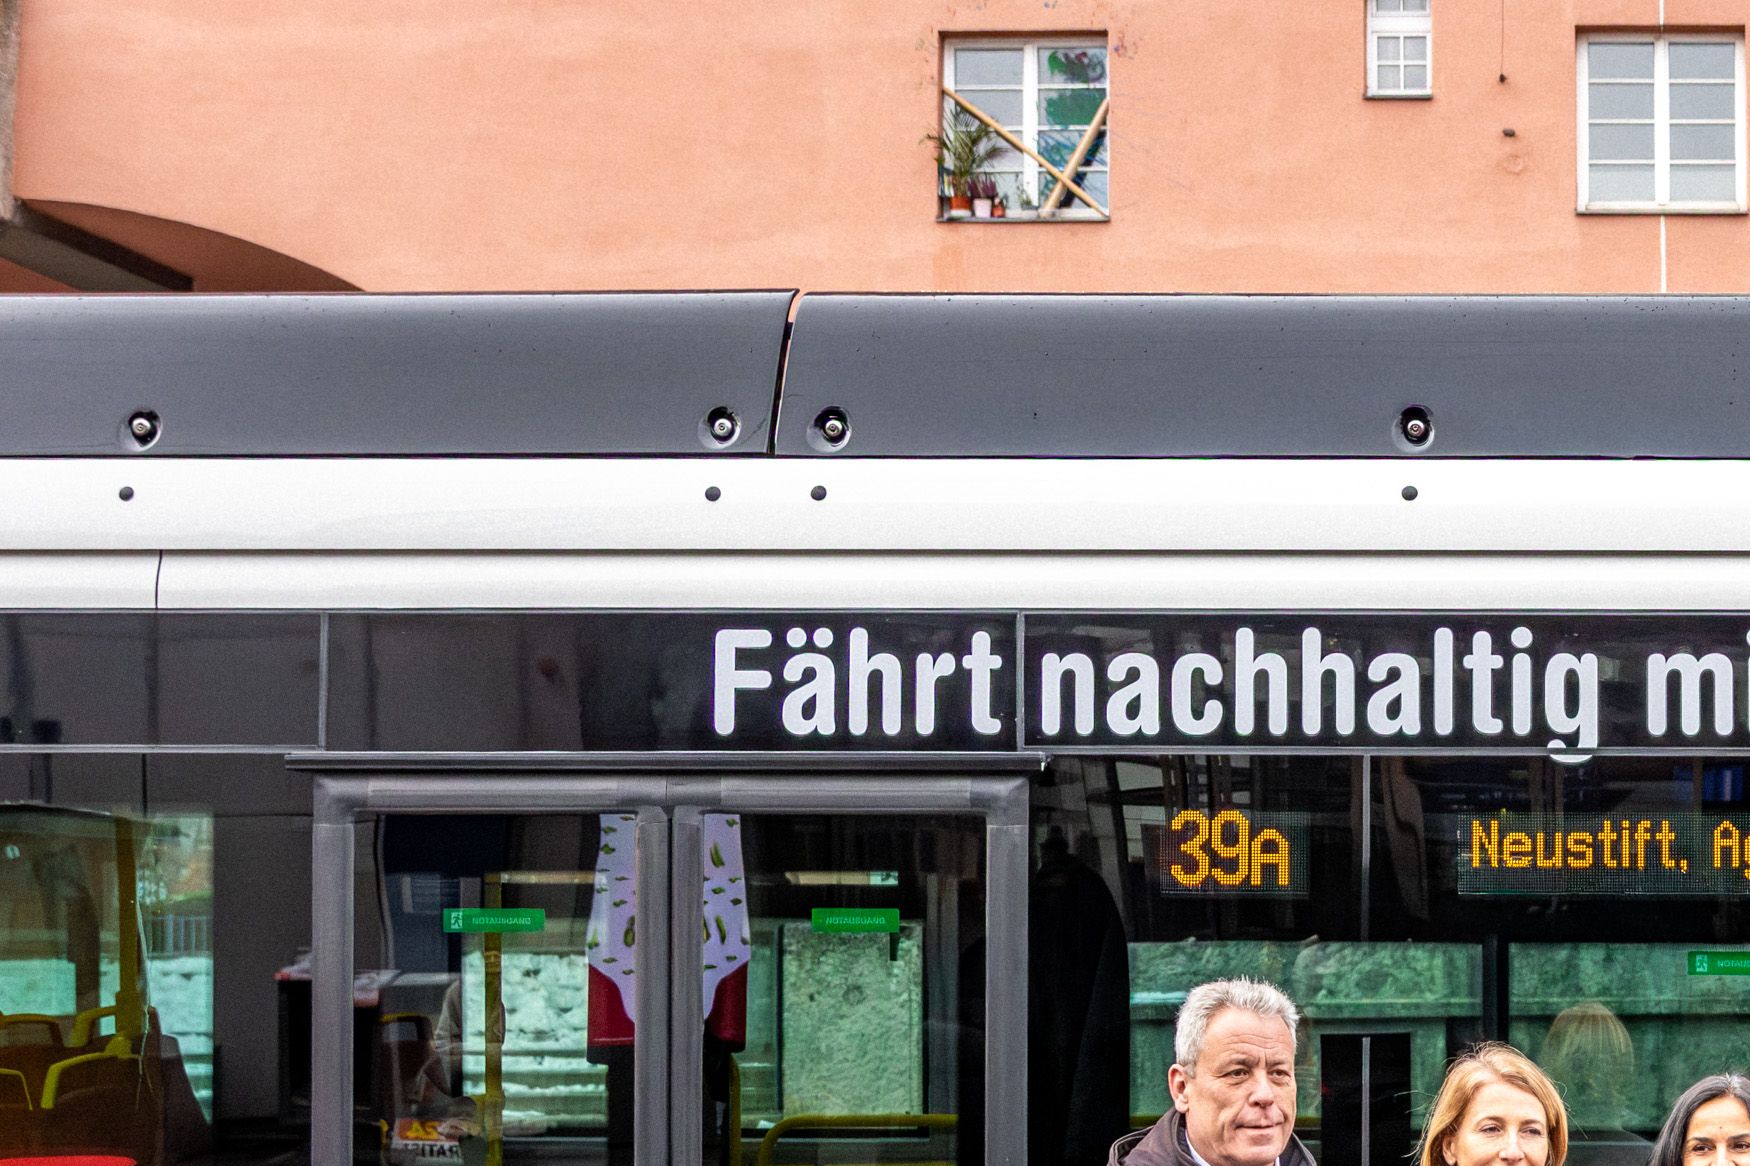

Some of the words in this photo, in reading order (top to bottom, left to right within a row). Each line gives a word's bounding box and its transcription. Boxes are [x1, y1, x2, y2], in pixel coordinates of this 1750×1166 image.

[713, 627, 1003, 736] Fährt
[1041, 626, 1599, 763] nachhaltig
[1170, 810, 1289, 887] 39A
[1471, 819, 1689, 874] Neustift,
